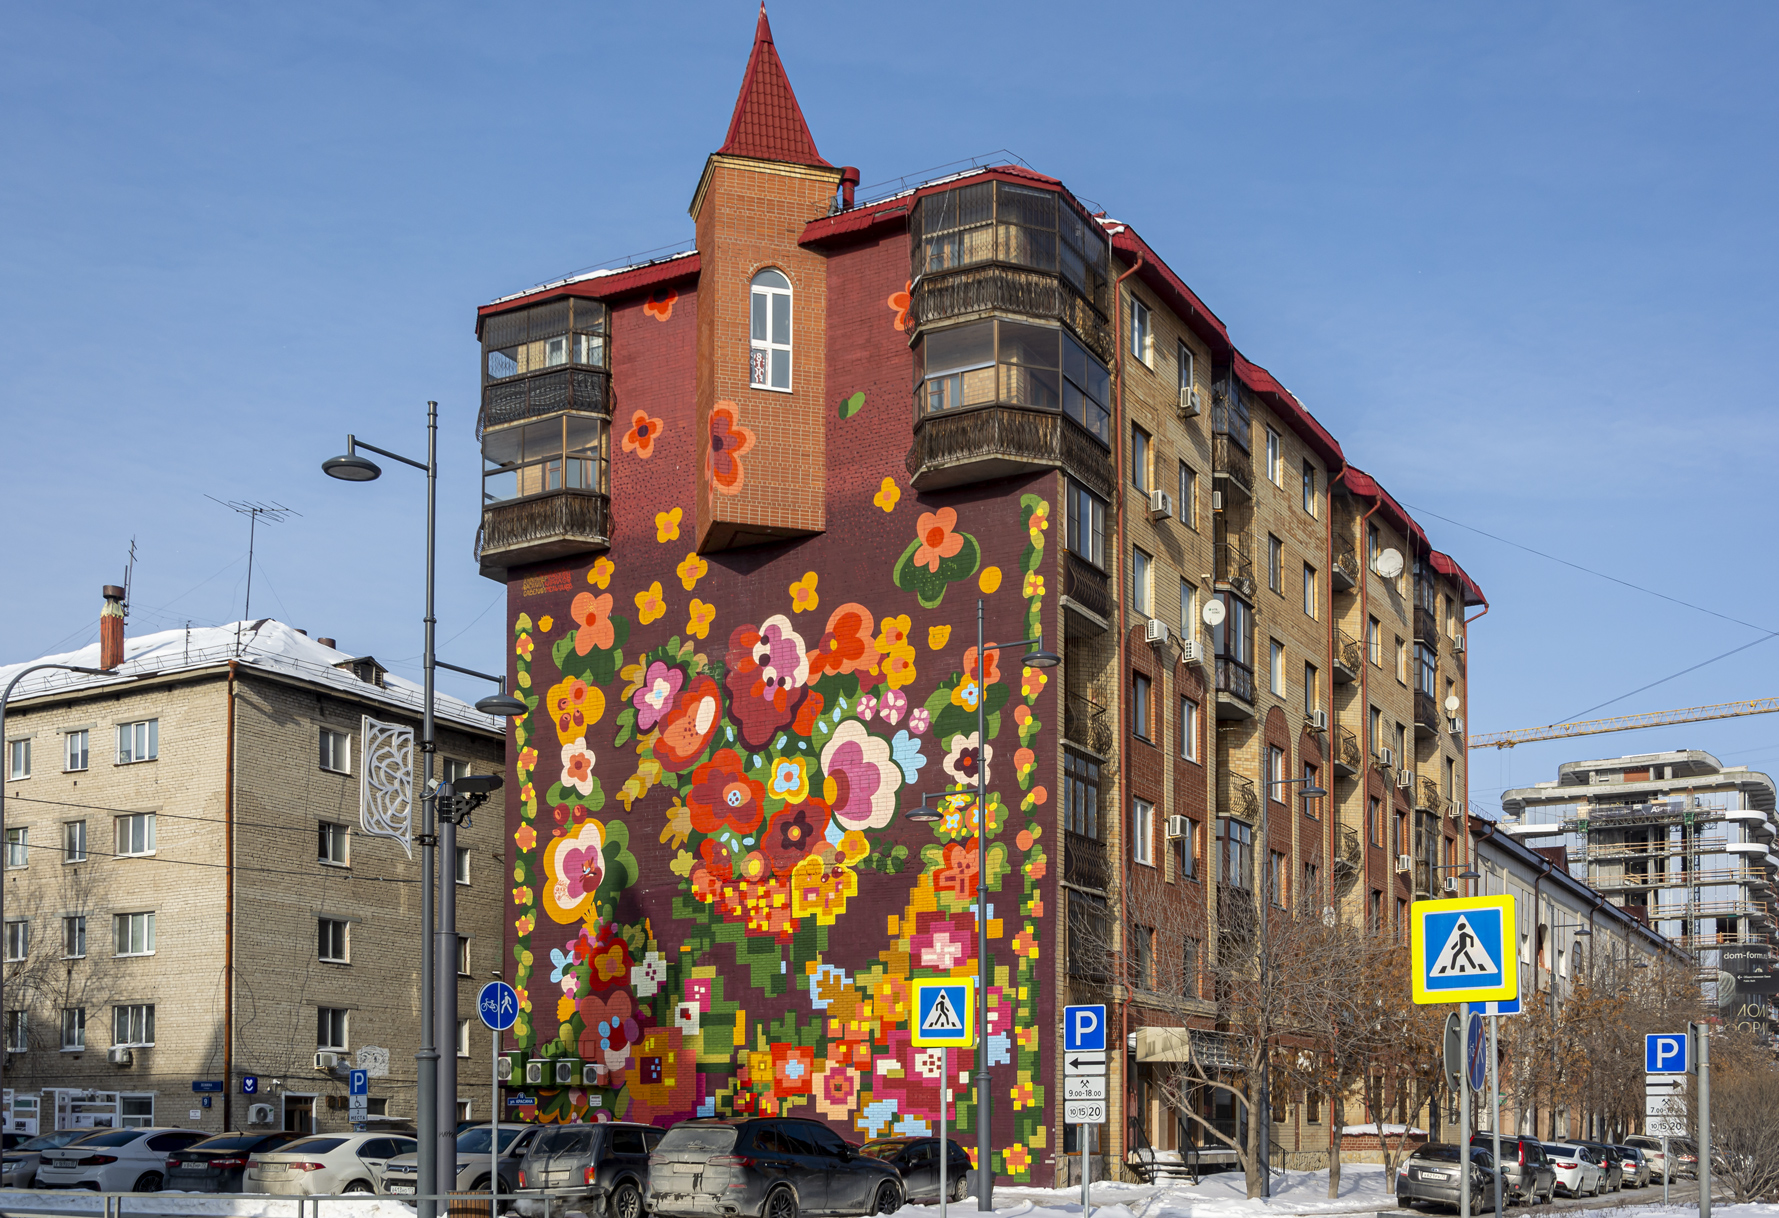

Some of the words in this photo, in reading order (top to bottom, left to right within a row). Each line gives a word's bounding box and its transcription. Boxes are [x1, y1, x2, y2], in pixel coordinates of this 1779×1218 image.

[1075, 1010, 1098, 1046] P
[1656, 1038, 1679, 1069] P
[354, 1072, 365, 1093] P
[1068, 1089, 1102, 1097] 9.00-18.00
[1069, 1108, 1077, 1116] 10
[1078, 1107, 1086, 1116] 15
[1088, 1106, 1101, 1117] 20
